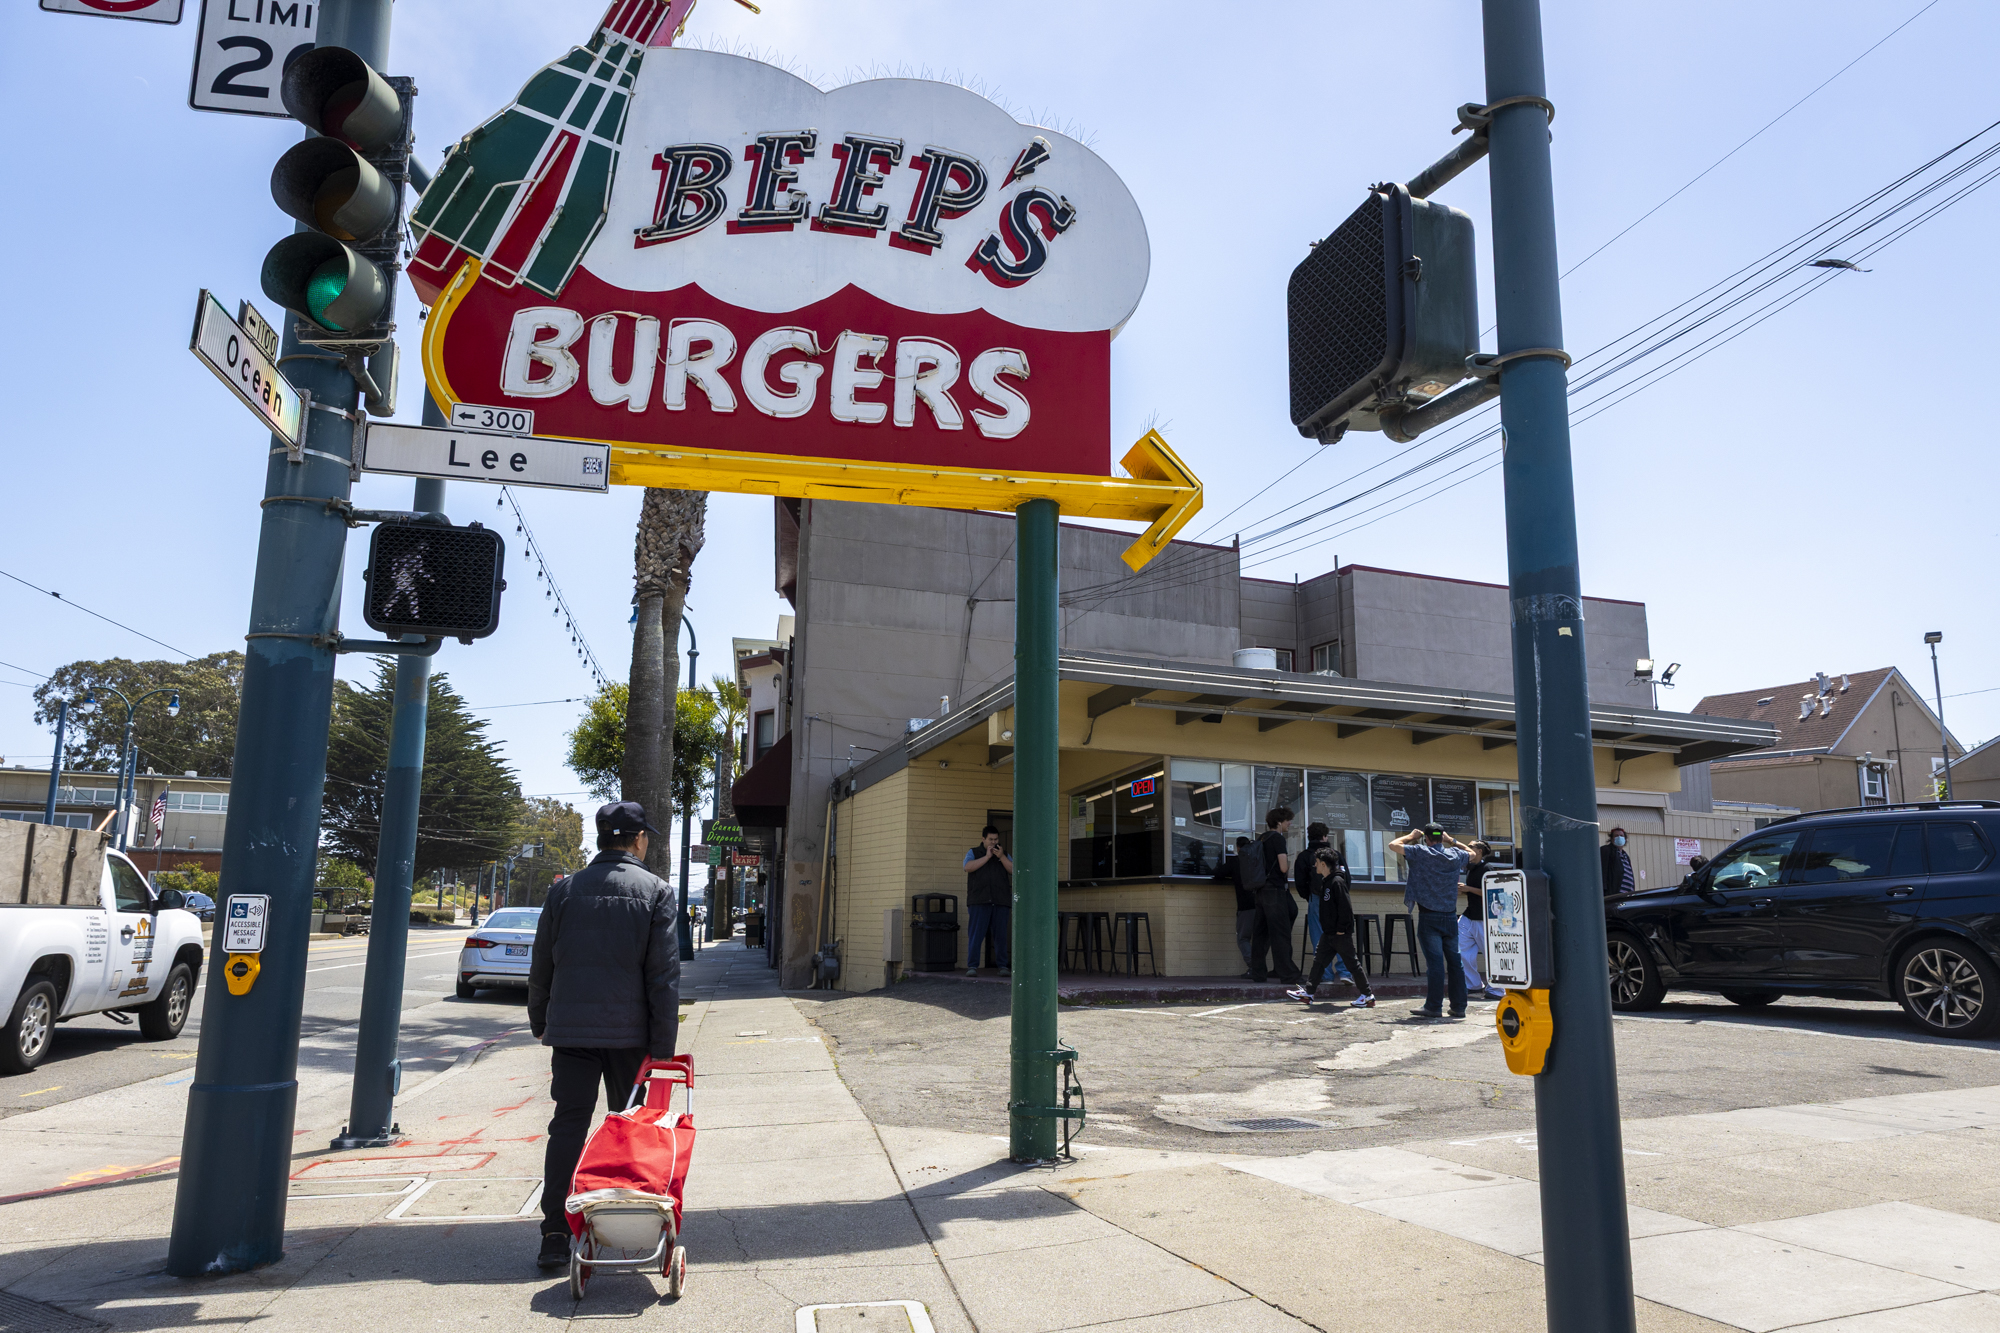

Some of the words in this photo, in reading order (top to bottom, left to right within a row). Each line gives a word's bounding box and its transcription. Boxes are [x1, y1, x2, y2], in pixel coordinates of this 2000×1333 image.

[228, 0, 319, 28] LIMI
[633, 128, 1077, 288] BEEP'S
[257, 320, 277, 355] 1100
[227, 334, 282, 417] Ocean
[501, 307, 1031, 439] BURGERS
[481, 409, 526, 431] 300
[448, 440, 527, 472] Lee
[1133, 779, 1153, 795] OPEN
[706, 831, 744, 844] Dispensa
[230, 920, 261, 928] ACCESSIBLE
[1494, 941, 1519, 954] MESSAGE
[1500, 958, 1515, 971] ONLY
